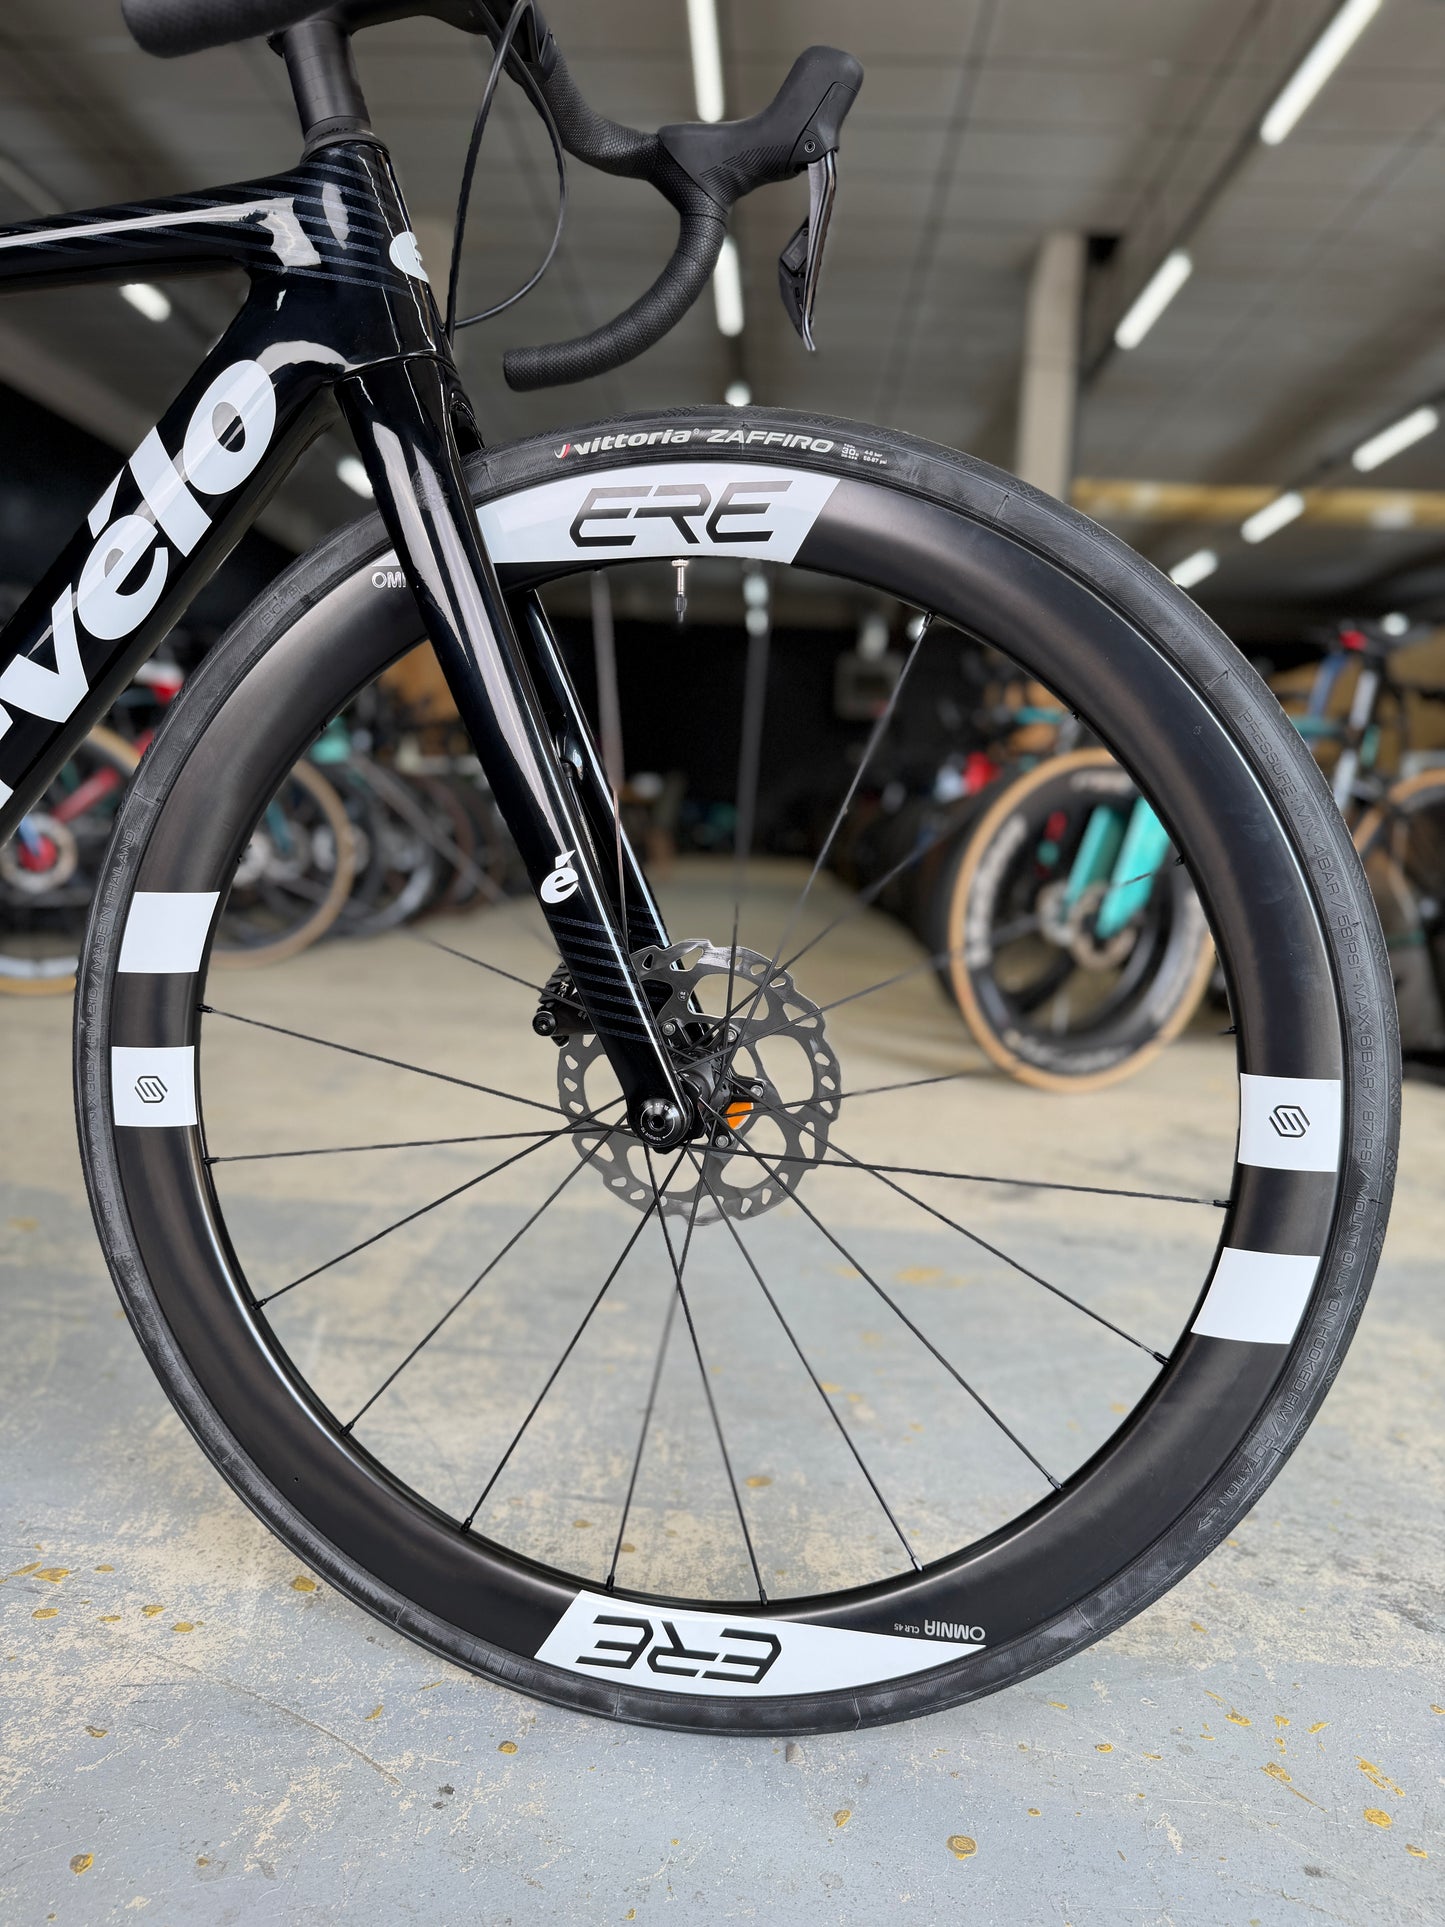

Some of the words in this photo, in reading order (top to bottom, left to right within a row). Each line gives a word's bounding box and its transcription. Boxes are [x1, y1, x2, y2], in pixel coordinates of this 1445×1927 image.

[706, 429, 835, 453] ZAFFIRO
[569, 480, 794, 548] ERE
[0, 359, 277, 809] vélo
[104, 830, 136, 904] THAILAND
[541, 849, 579, 904] é
[99, 908, 112, 923] IN
[1336, 913, 1353, 939] 58
[90, 924, 109, 970] MADE
[1343, 941, 1360, 969] PSI
[1353, 983, 1370, 1029] MAX.
[1361, 1110, 1375, 1132] 87
[1358, 1137, 1374, 1164] PSI
[1344, 1185, 1370, 1247] MOUNT
[1332, 1251, 1356, 1295] ONLY
[1323, 1299, 1341, 1323] ON
[1291, 1325, 1333, 1391] HOOKED
[1275, 1393, 1301, 1422] RIM
[1215, 1434, 1276, 1506] ROTATION
[575, 1614, 783, 1684] ERE
[904, 1624, 920, 1634] CLR
[924, 1619, 986, 1642] OMNIA
